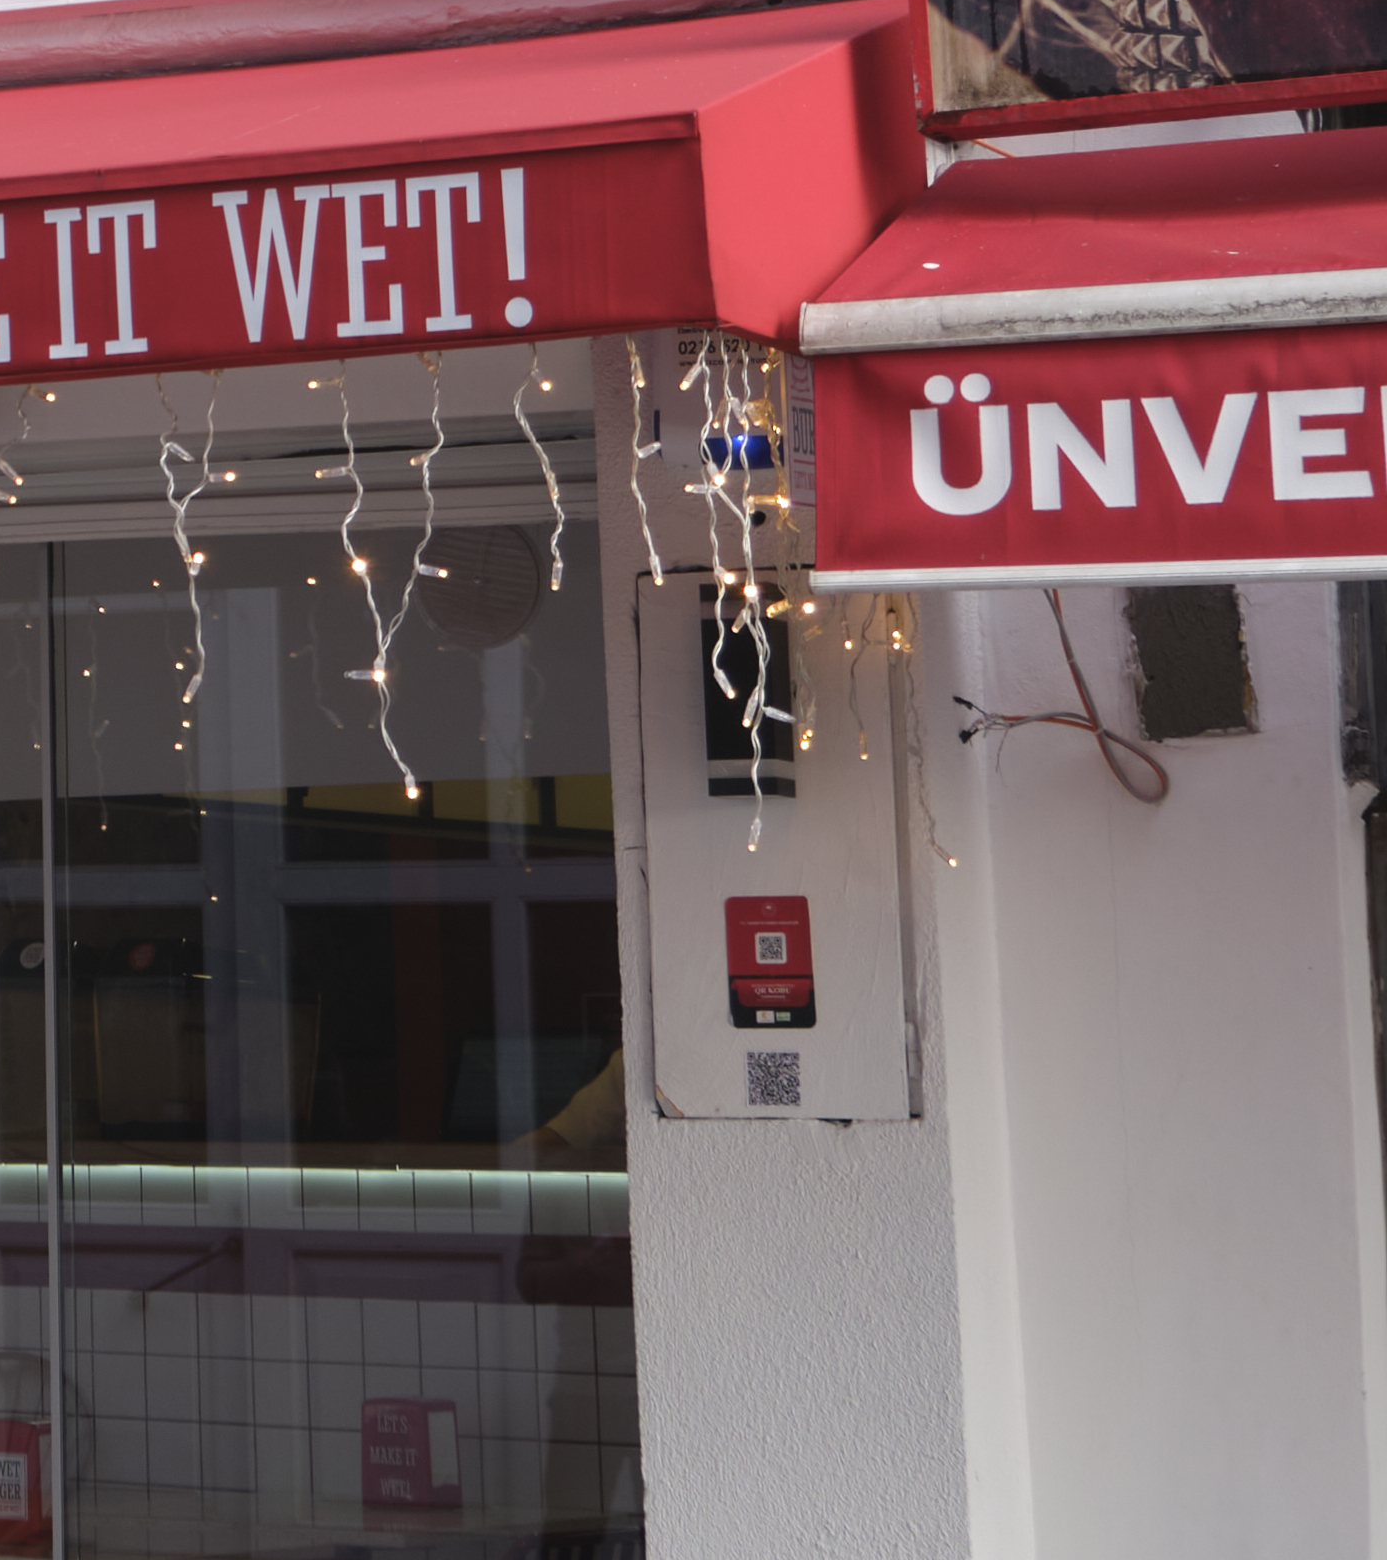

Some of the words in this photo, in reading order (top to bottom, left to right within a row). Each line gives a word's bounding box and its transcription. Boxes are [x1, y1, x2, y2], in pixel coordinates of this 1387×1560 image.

[44, 200, 156, 359] IT
[212, 167, 533, 343] WET!
[910, 373, 1387, 516] ÜNVE
[370, 1446, 402, 1466] MAKE
